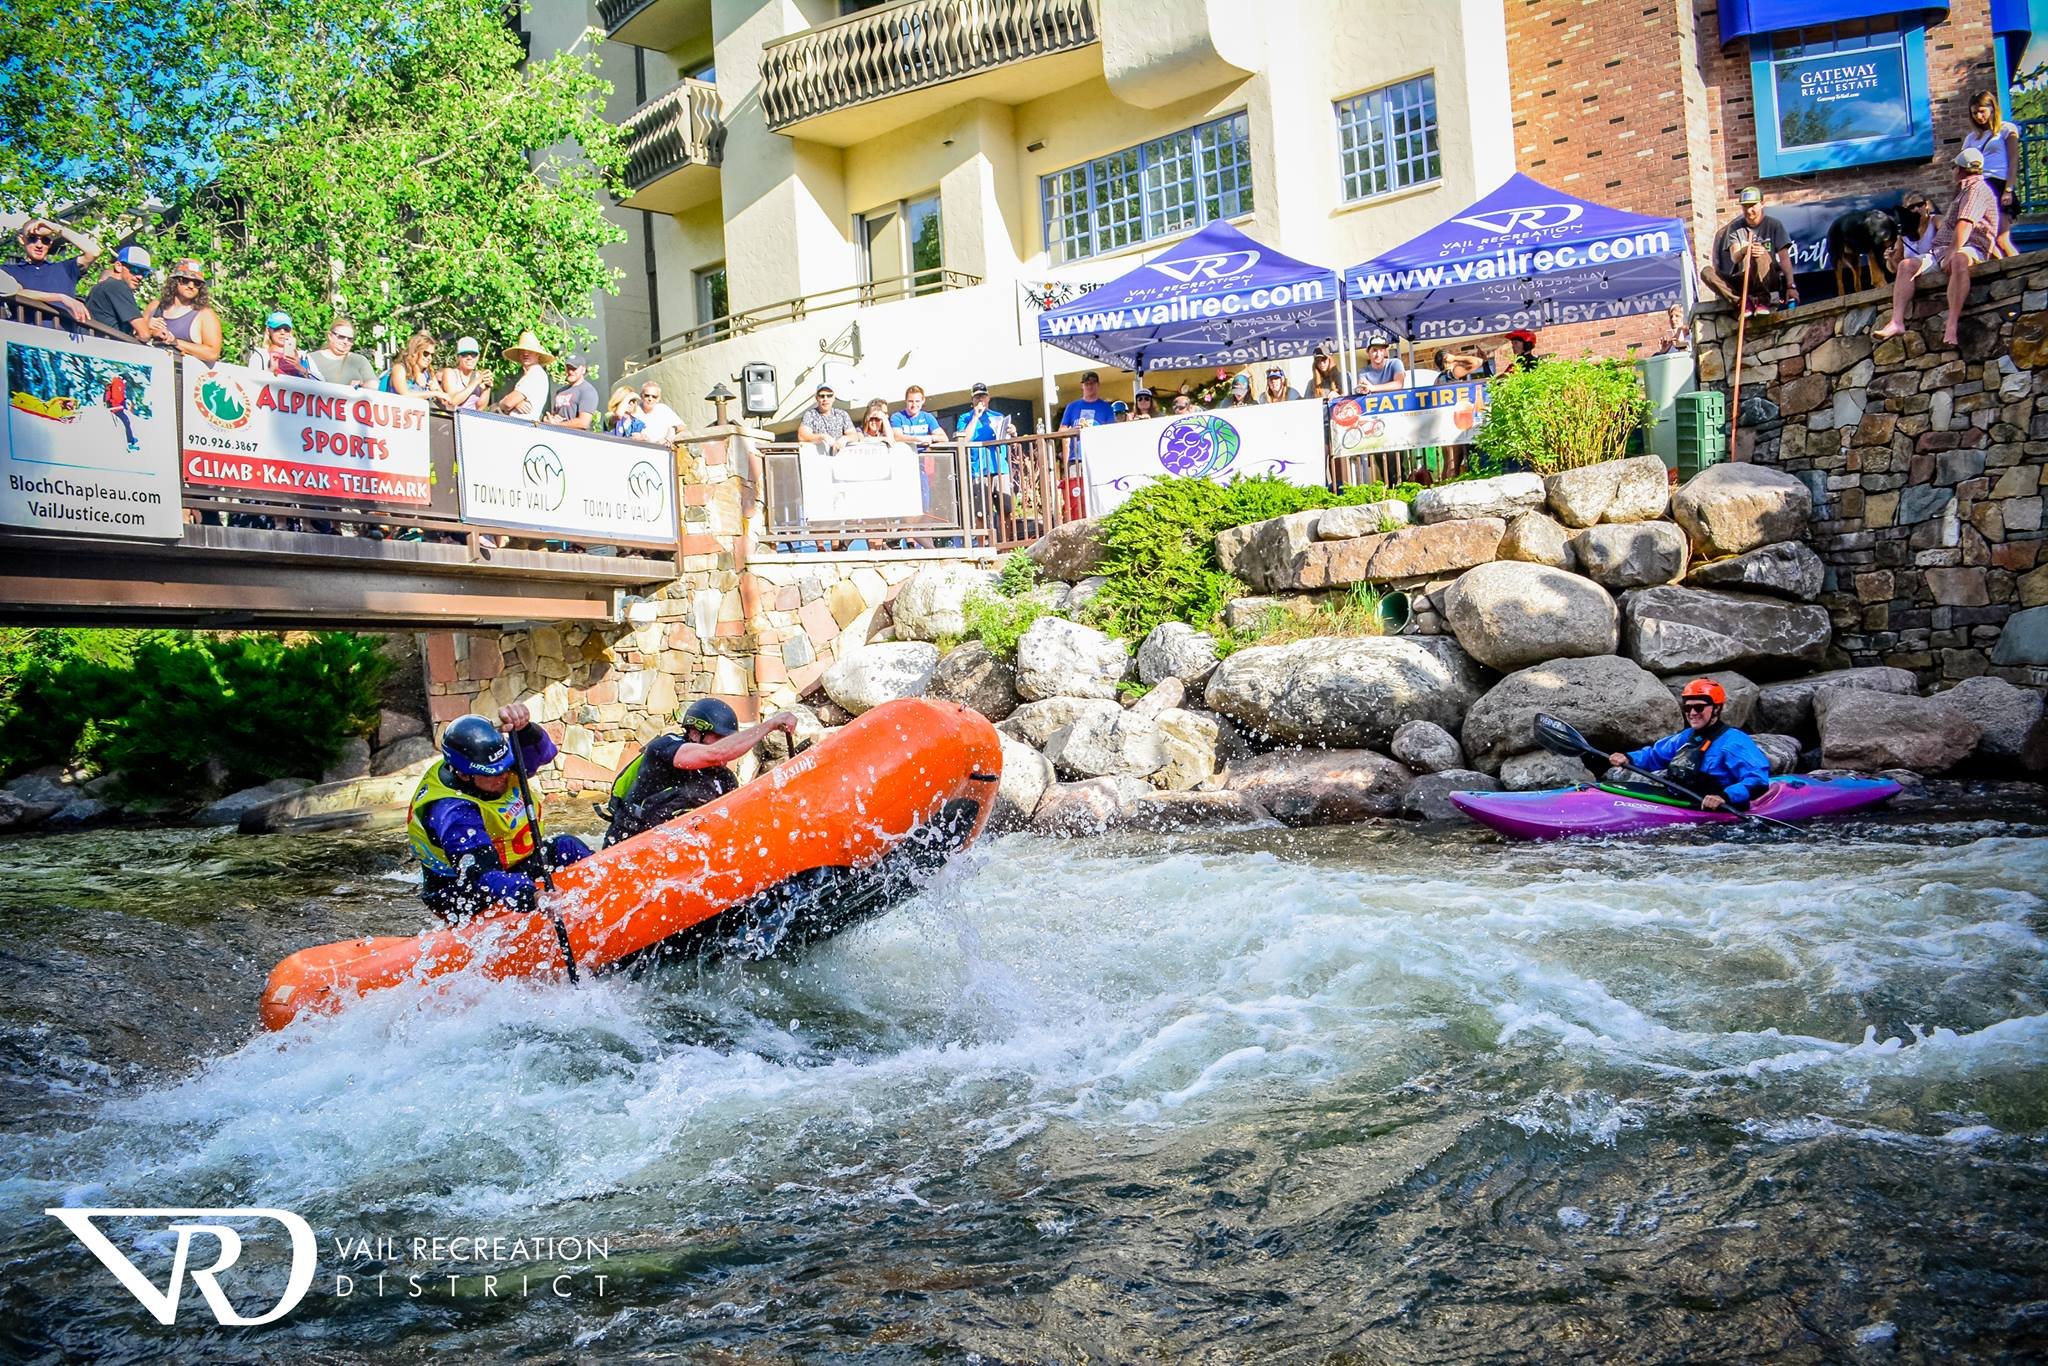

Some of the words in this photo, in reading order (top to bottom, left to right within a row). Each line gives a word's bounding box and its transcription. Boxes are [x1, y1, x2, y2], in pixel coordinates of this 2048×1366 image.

[1800, 63, 1877, 84] GATEWAY
[1801, 85, 1830, 97] REAL
[1835, 78, 1878, 92] ESTATE
[1439, 230, 1584, 257] DISTRICT
[1441, 239, 1474, 250] VAIL
[1481, 223, 1584, 245] RECREATION
[1356, 229, 1671, 296] www.vailrec.com
[1123, 279, 1252, 304] DISTRICT
[1128, 287, 1157, 298] VAIL
[1163, 273, 1254, 291] RECREATION
[1047, 280, 1324, 336] www.vailrec.com
[256, 384, 349, 422] ALPINE
[352, 400, 426, 431] QUEST
[1365, 393, 1408, 413] FAT
[1415, 387, 1470, 408] TIRE
[188, 434, 258, 452] 970.926.3867
[301, 426, 390, 461] SPORTS
[9, 474, 161, 505] BlochChapleau.com
[187, 456, 253, 482] CLIMB
[262, 463, 331, 490] KAYAK
[338, 473, 428, 499] TELEMARK
[472, 483, 506, 505] TOWN
[509, 489, 523, 508] OF
[526, 491, 550, 512] VAIL
[28, 501, 146, 526] VailJustice.com
[583, 499, 612, 519] TOWN
[616, 504, 628, 520] OF
[630, 506, 652, 523] VAIL
[488, 744, 509, 762] USA
